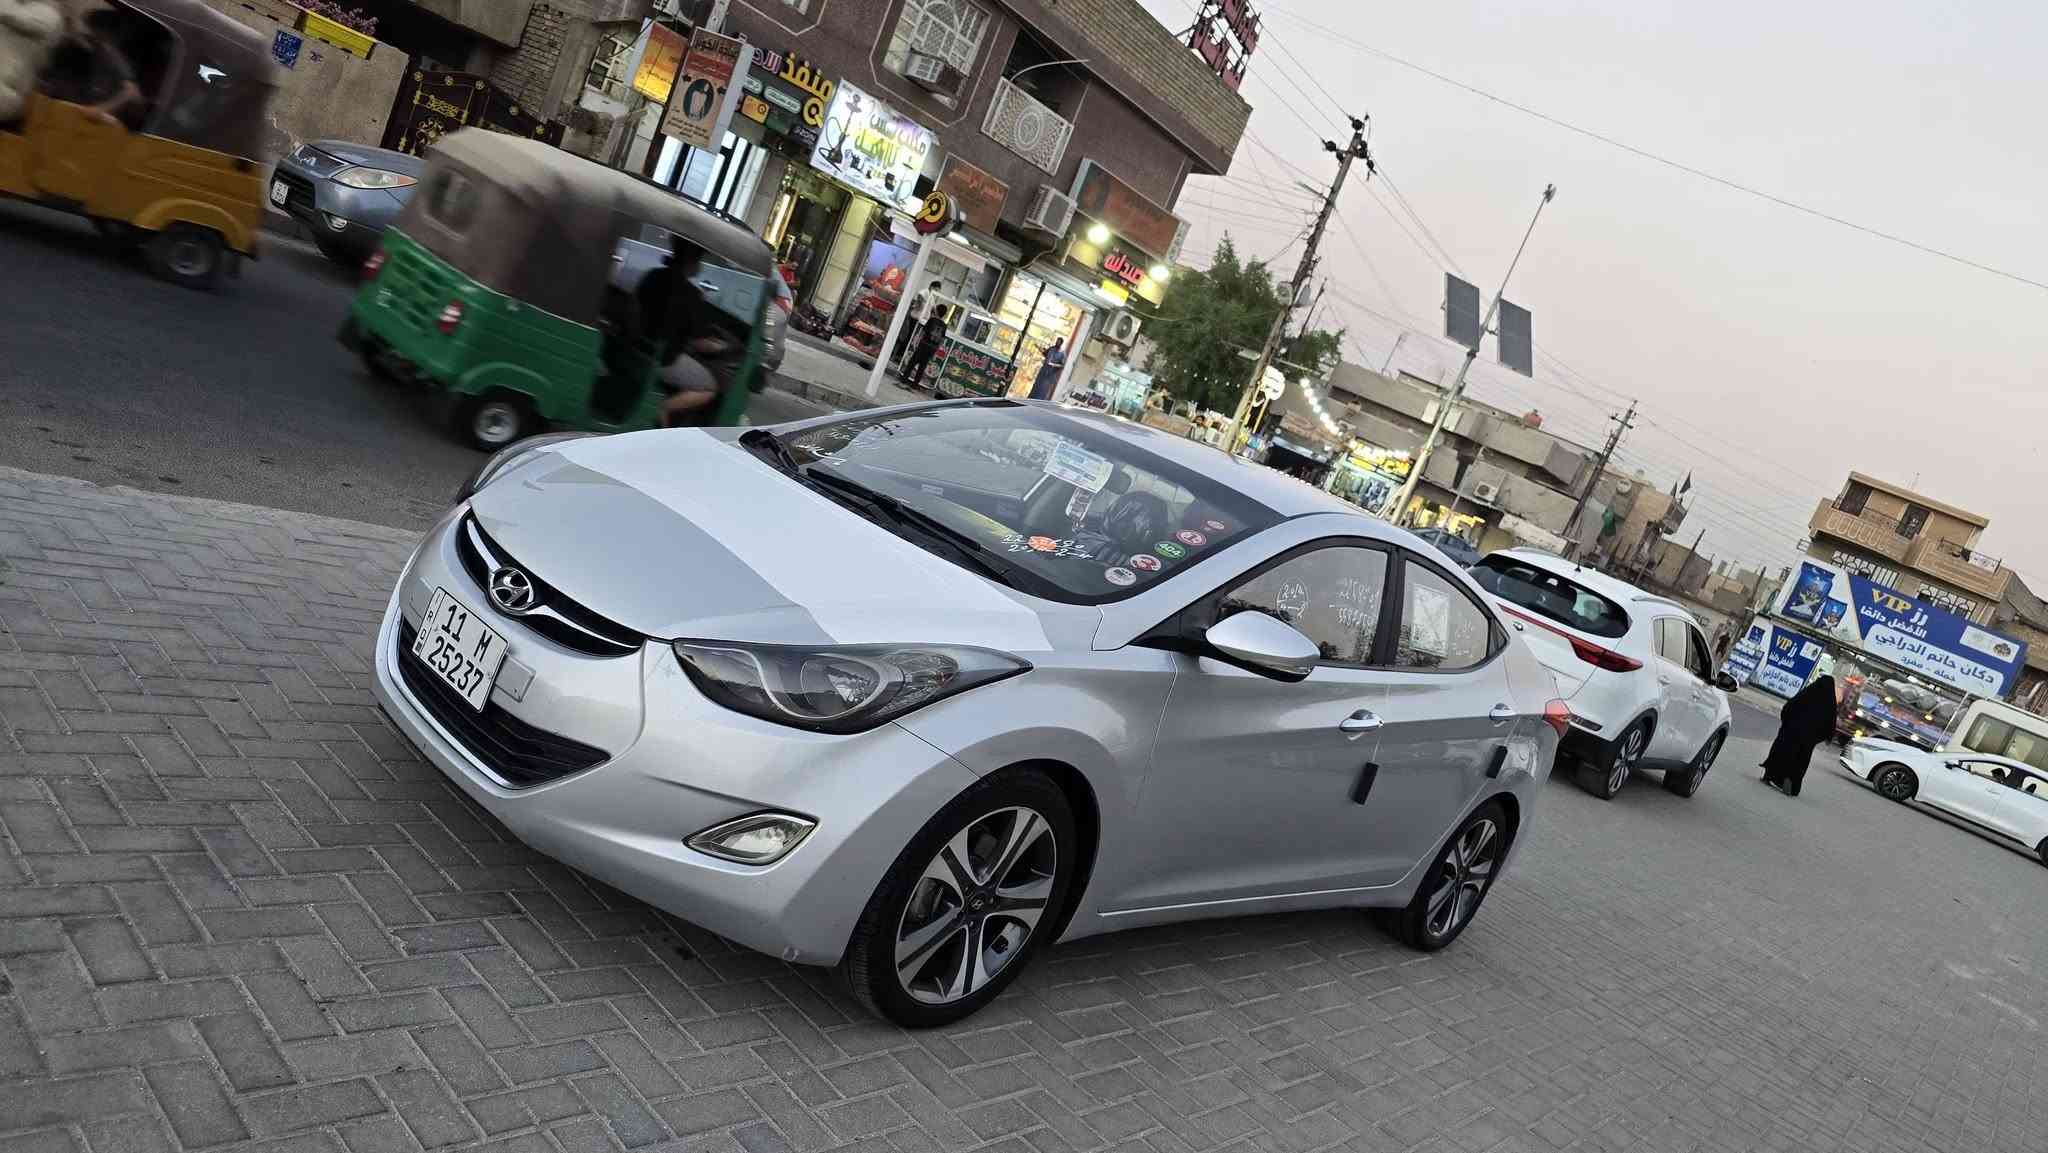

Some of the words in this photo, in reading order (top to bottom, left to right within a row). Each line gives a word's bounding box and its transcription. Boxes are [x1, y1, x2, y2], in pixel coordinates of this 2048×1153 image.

[778, 51, 834, 102] منفذ
[1871, 588, 1912, 615] VIP
[1909, 607, 1929, 627] رز
[440, 604, 468, 643] 11
[473, 629, 493, 663] M
[1776, 634, 1793, 651] VIP
[1874, 631, 1927, 658] الدراجي
[427, 637, 485, 698] 25237
[1900, 655, 1925, 670] مفرد
[1926, 651, 1957, 671] حاتم
[1959, 662, 1995, 685] دكان
